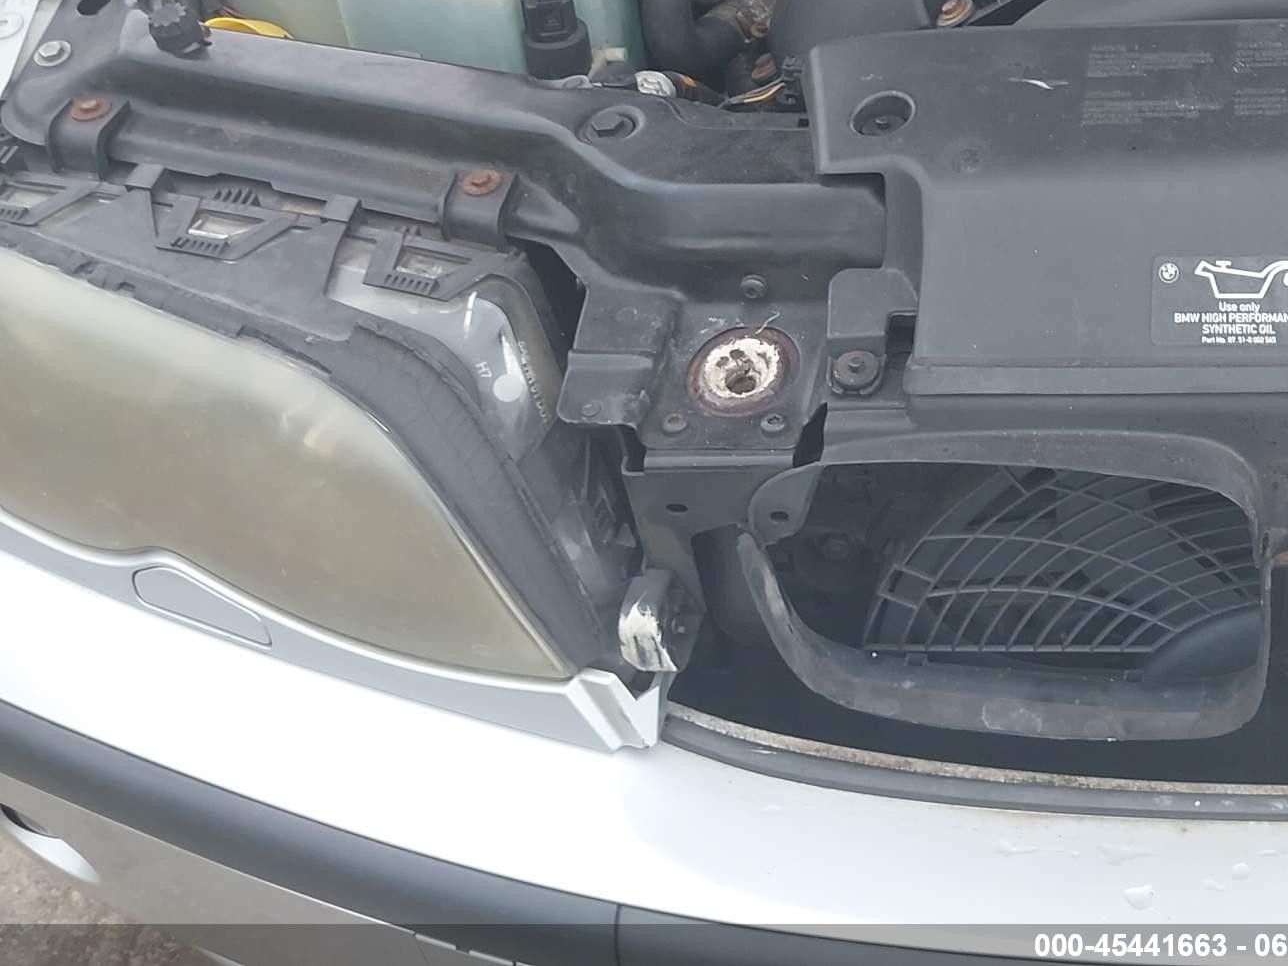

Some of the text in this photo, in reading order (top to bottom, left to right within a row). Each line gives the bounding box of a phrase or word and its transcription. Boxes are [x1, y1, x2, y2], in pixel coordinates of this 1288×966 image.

[1218, 301, 1260, 315] Use only
[1174, 312, 1200, 323] BMW
[1201, 312, 1227, 323] HIGH
[1202, 324, 1276, 334] SYNTHETIC OIL
[1201, 336, 1215, 344] Part
[476, 361, 493, 378] H7
